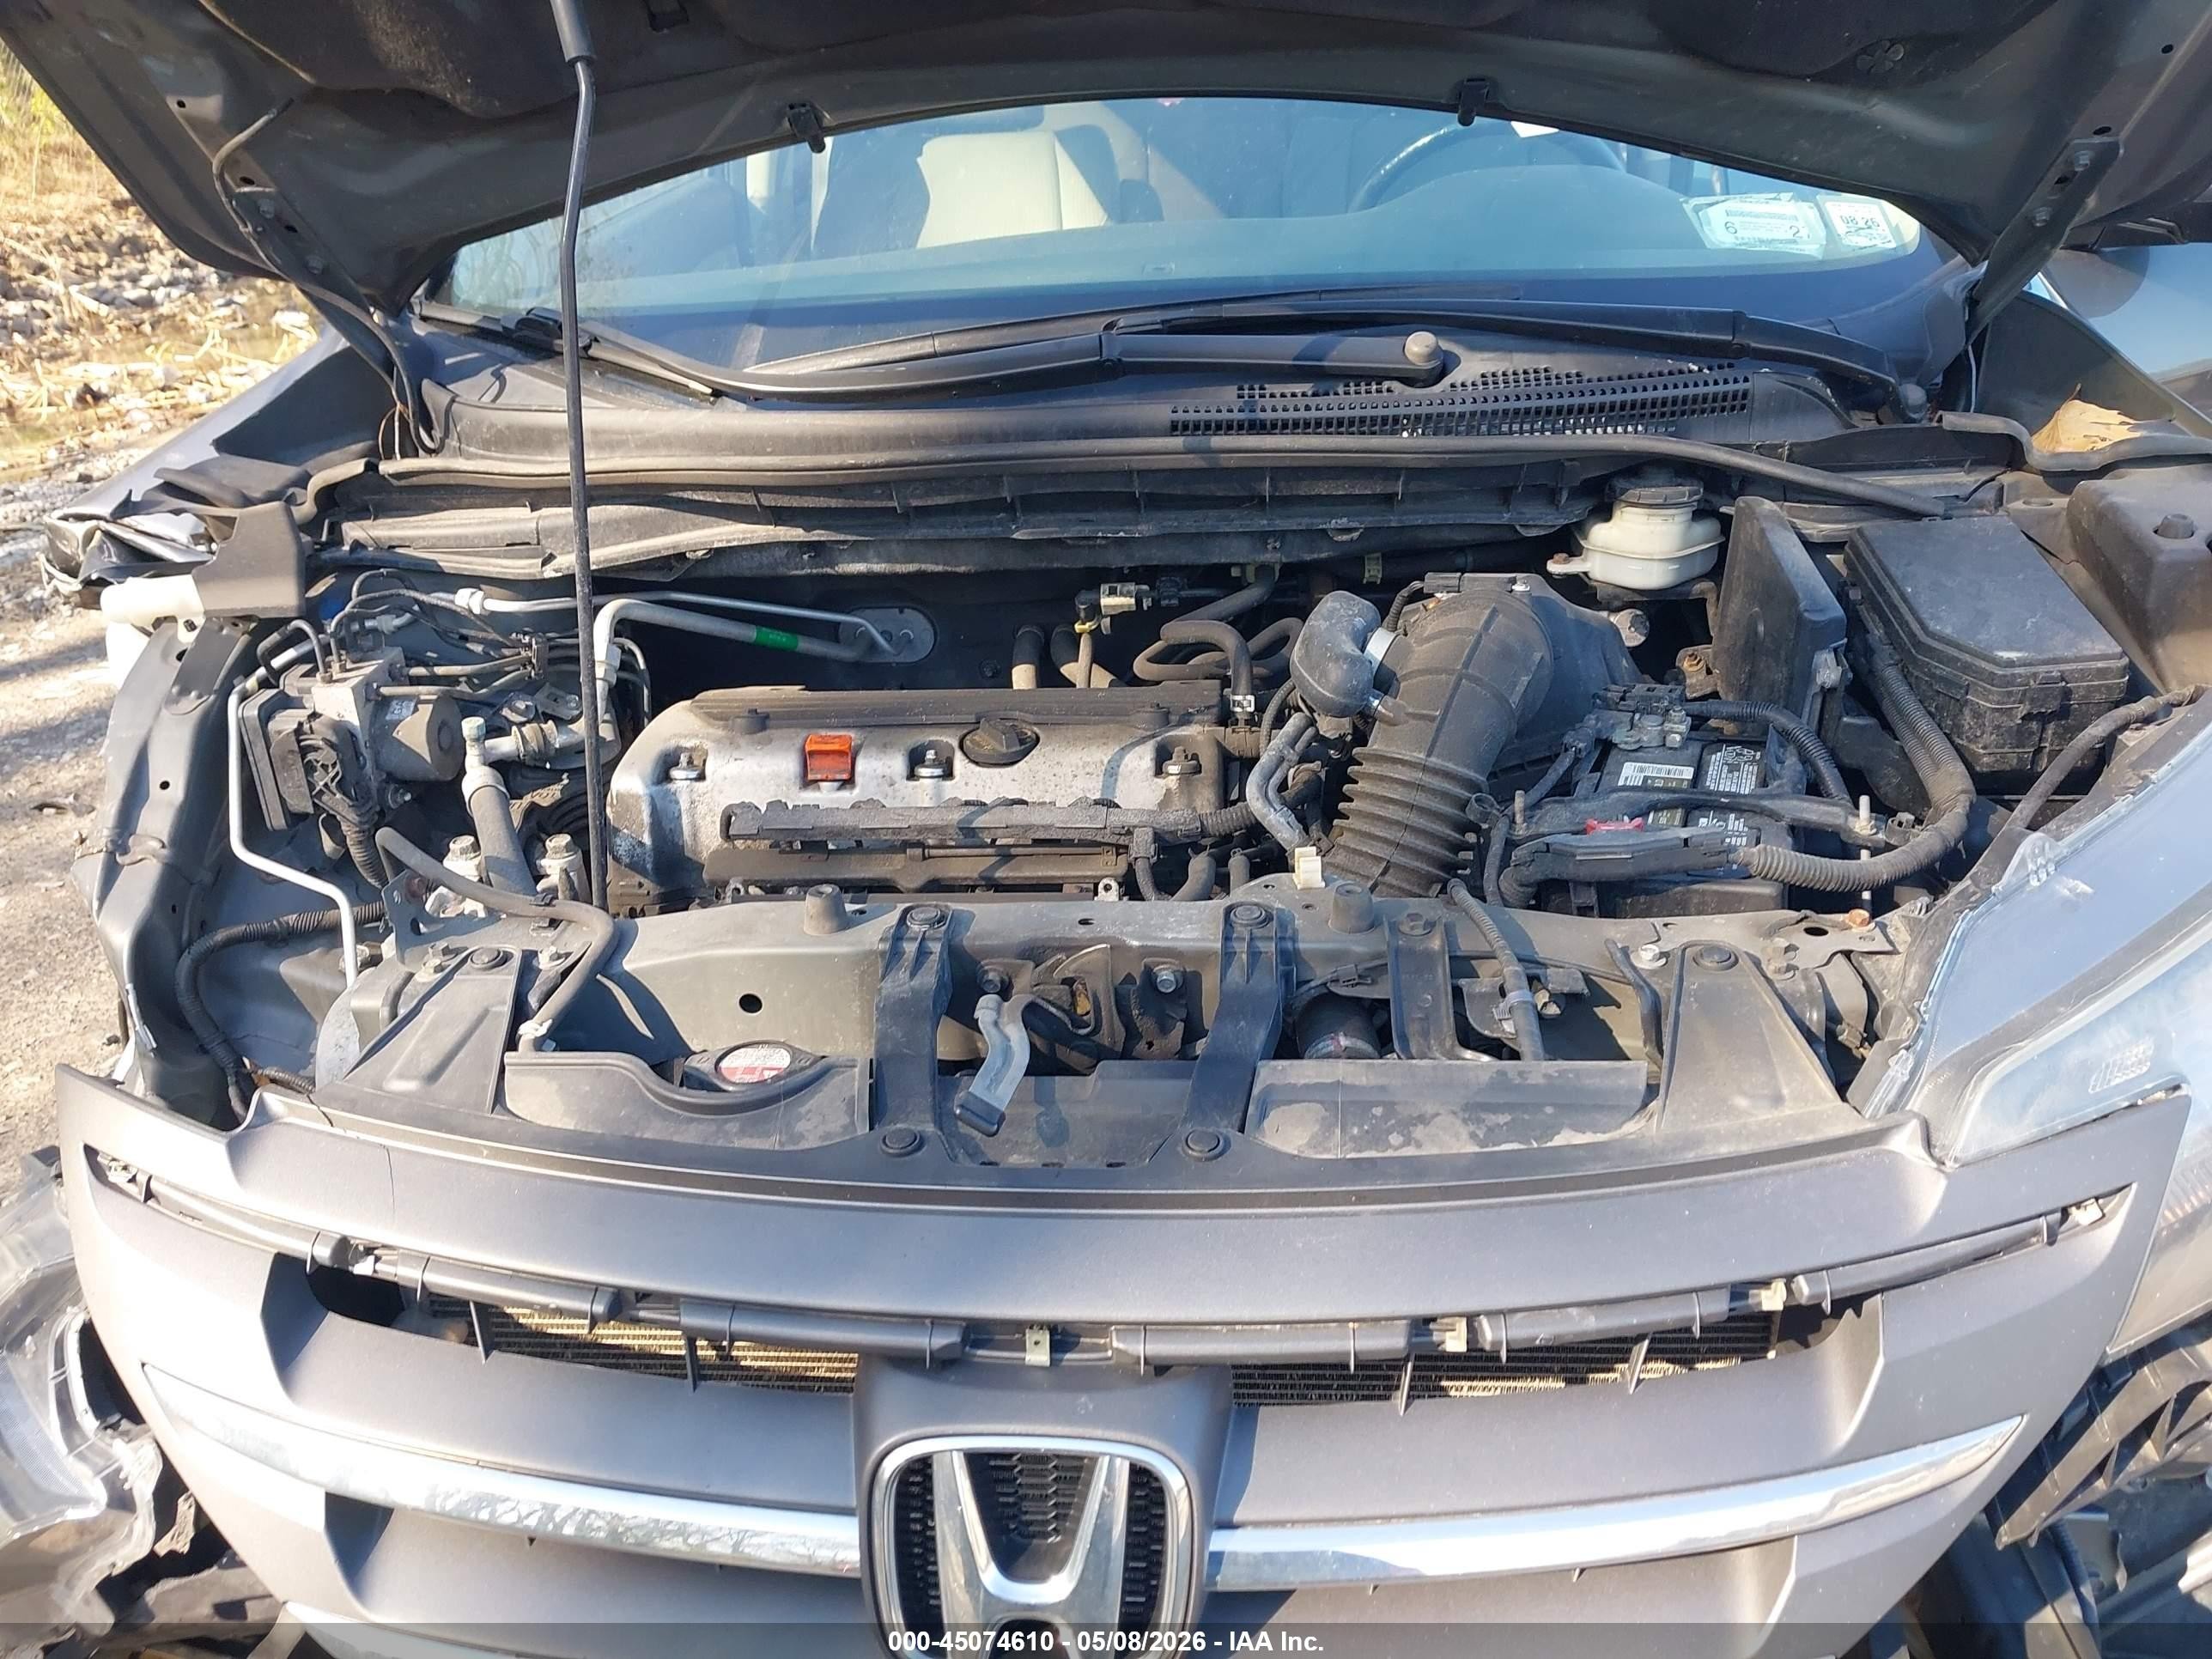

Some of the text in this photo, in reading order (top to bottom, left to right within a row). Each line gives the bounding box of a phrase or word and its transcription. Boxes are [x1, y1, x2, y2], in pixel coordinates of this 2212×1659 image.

[1724, 221, 1738, 234] 6
[1839, 215, 1881, 228] 08 26
